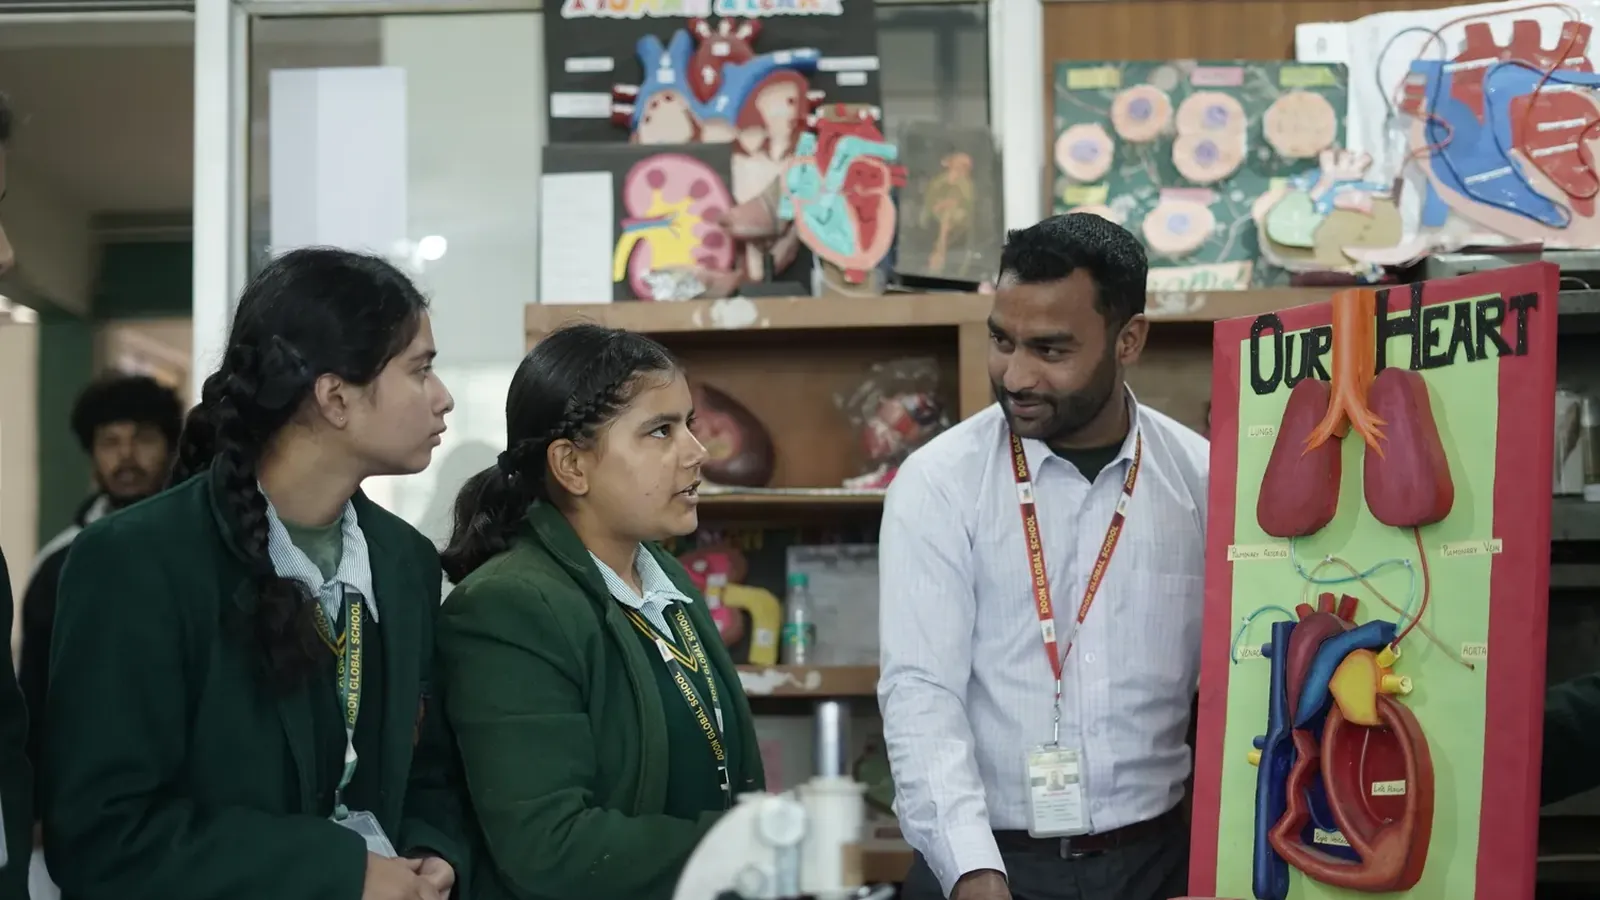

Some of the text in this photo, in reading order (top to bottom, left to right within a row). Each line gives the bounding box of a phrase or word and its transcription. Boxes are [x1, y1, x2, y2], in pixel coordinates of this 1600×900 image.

[1249, 281, 1539, 395] OUR HEART
[1015, 453, 1027, 478] DOON
[1250, 427, 1274, 437] LUNGS
[1026, 514, 1049, 614] DOON GLOBAL SCHOOL
[1079, 524, 1119, 617] DOON GLOBAL SCHOOL
[347, 601, 361, 725] DOON GLOBAL SCHOOL
[675, 608, 718, 702] DOON GLOBAL SCHOOL
[674, 671, 725, 761] DOON GLOBAL SCHOOL
